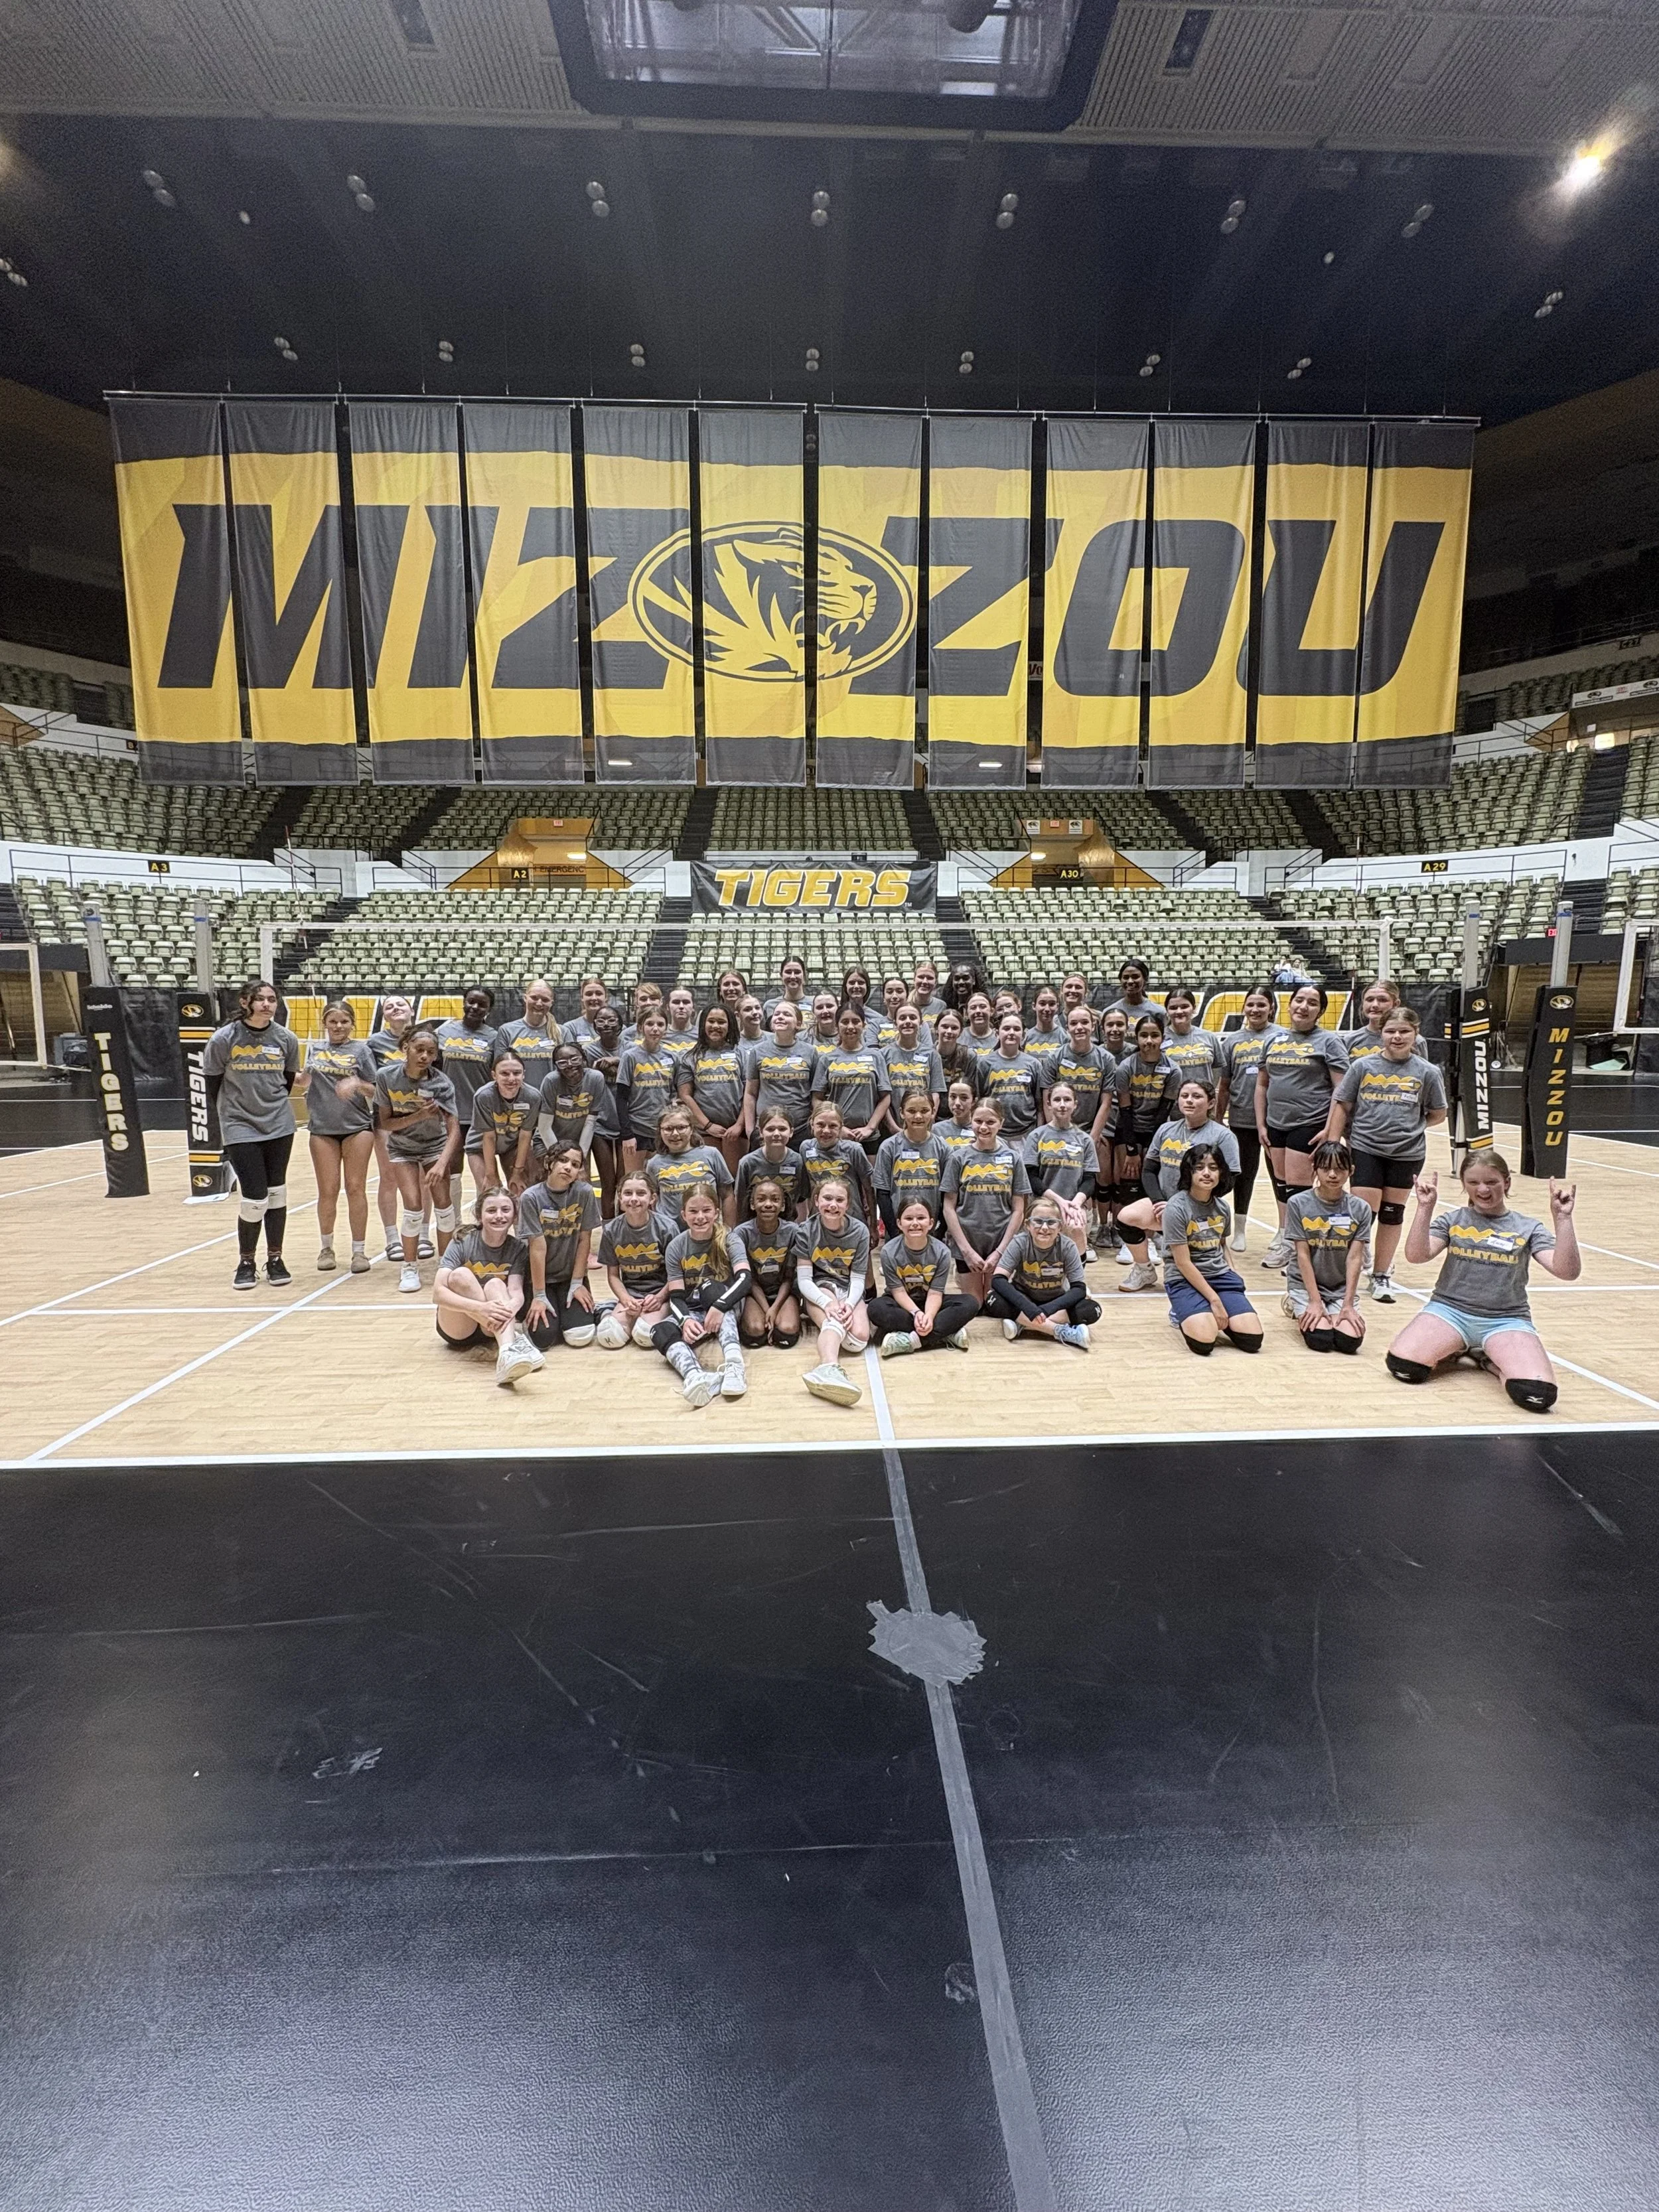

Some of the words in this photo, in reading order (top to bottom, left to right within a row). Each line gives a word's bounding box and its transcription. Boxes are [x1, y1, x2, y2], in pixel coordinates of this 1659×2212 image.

[714, 869, 912, 907] TIGERS
[1423, 861, 1446, 871] A29
[94, 1033, 129, 1151] TIGERS
[187, 1051, 209, 1142] TIGERS
[1475, 1041, 1490, 1130] MIZZOU
[1545, 1028, 1570, 1146] MIZZOU
